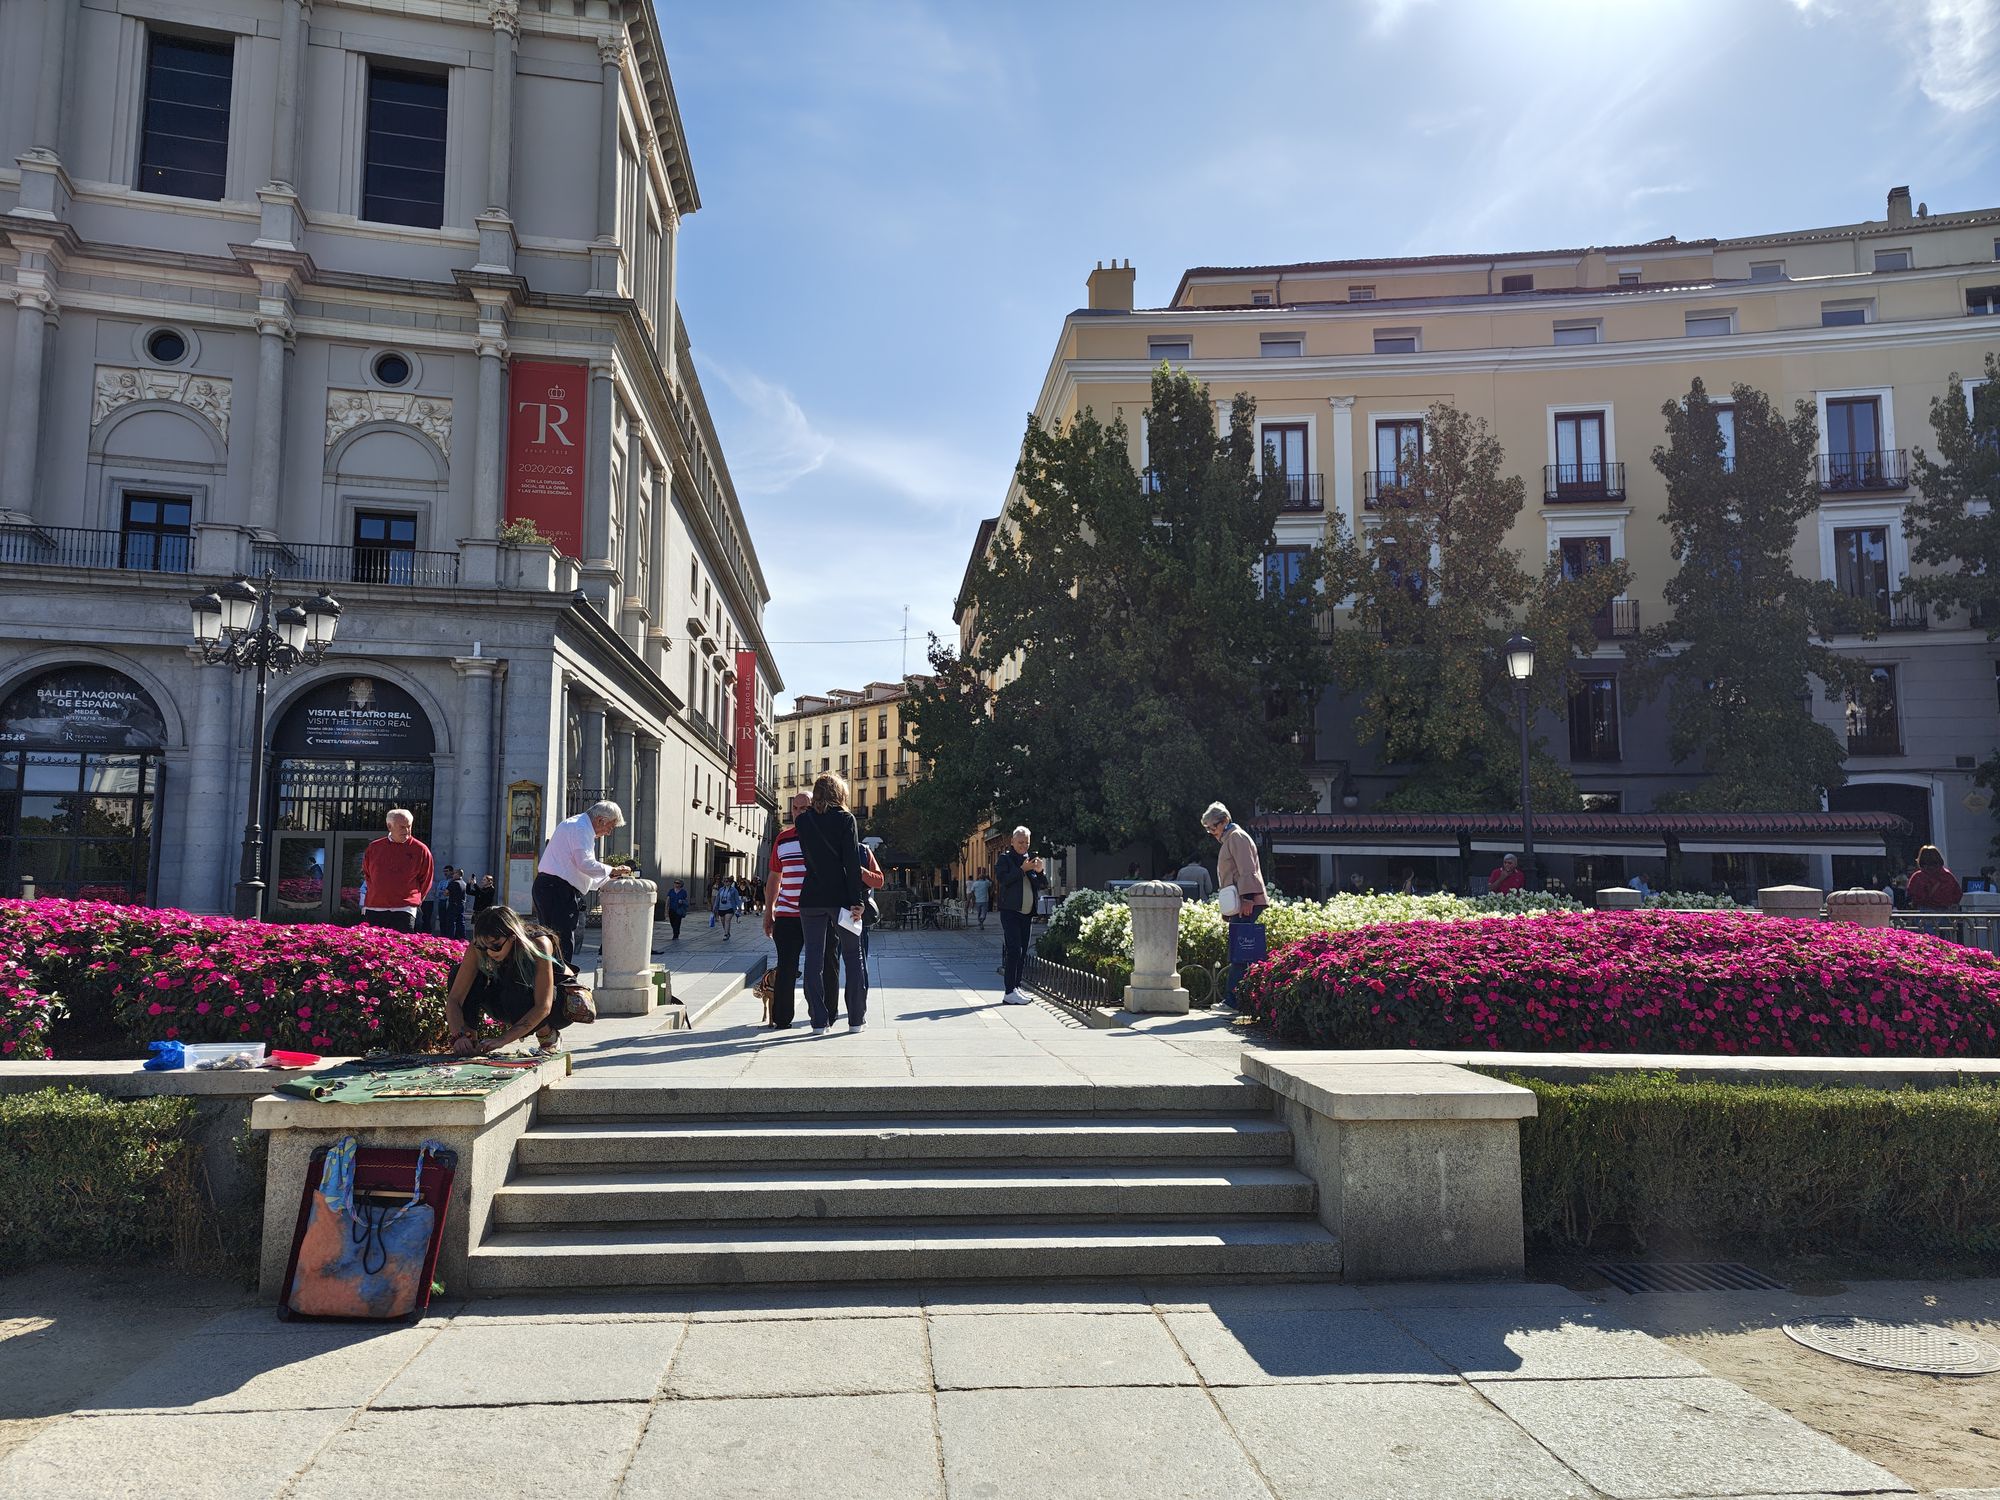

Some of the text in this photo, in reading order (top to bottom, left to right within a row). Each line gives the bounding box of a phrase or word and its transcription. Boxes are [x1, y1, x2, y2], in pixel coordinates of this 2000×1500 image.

[518, 463, 574, 475] 2020/2026
[37, 689, 139, 700] BALLET NACIONAL
[57, 699, 118, 709] DE ESPAÑA
[308, 709, 412, 720] VISITA EL TEATRO REAL
[307, 717, 411, 728] VISIT THE TEATRO REAL
